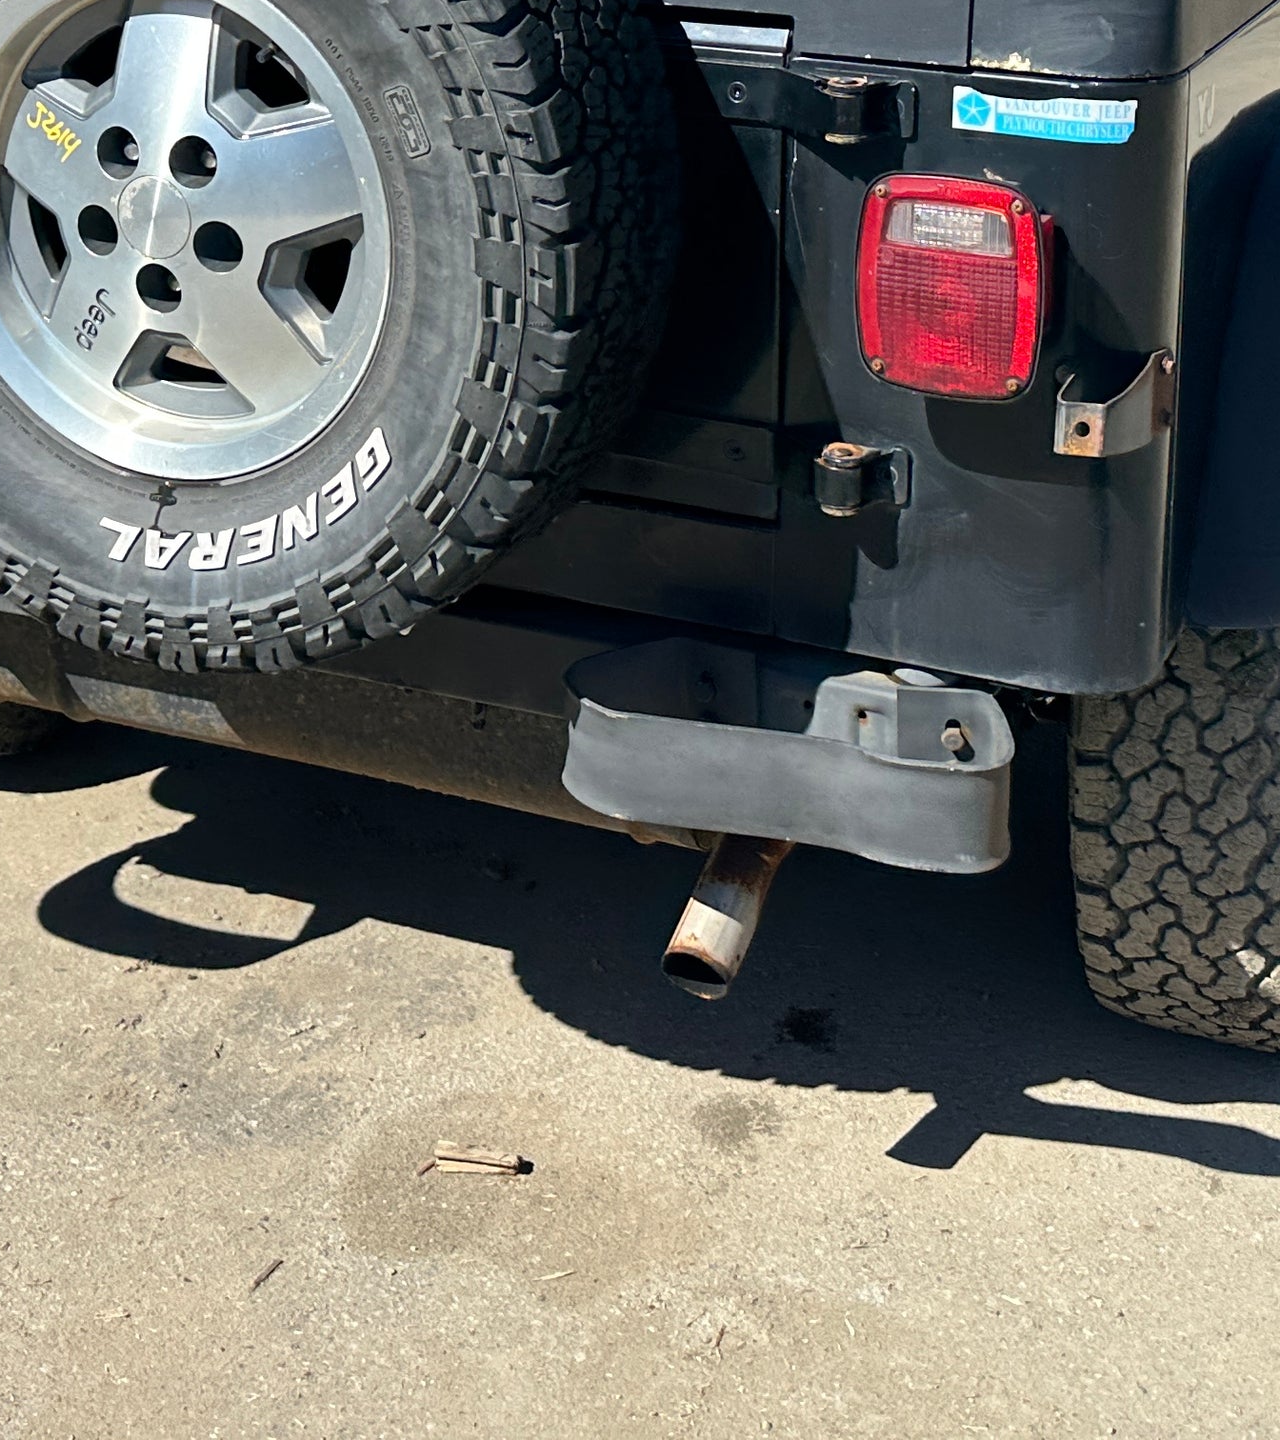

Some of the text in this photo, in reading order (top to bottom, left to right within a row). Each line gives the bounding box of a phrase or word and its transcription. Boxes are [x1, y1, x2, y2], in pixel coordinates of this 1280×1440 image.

[27, 101, 81, 163] J2614
[1003, 98, 1132, 121] VANCOUVER JEEP
[1003, 115, 1129, 140] PLYMOUTH CHRYSLER
[73, 288, 116, 352] Jeep
[100, 426, 392, 572] GENERAL
